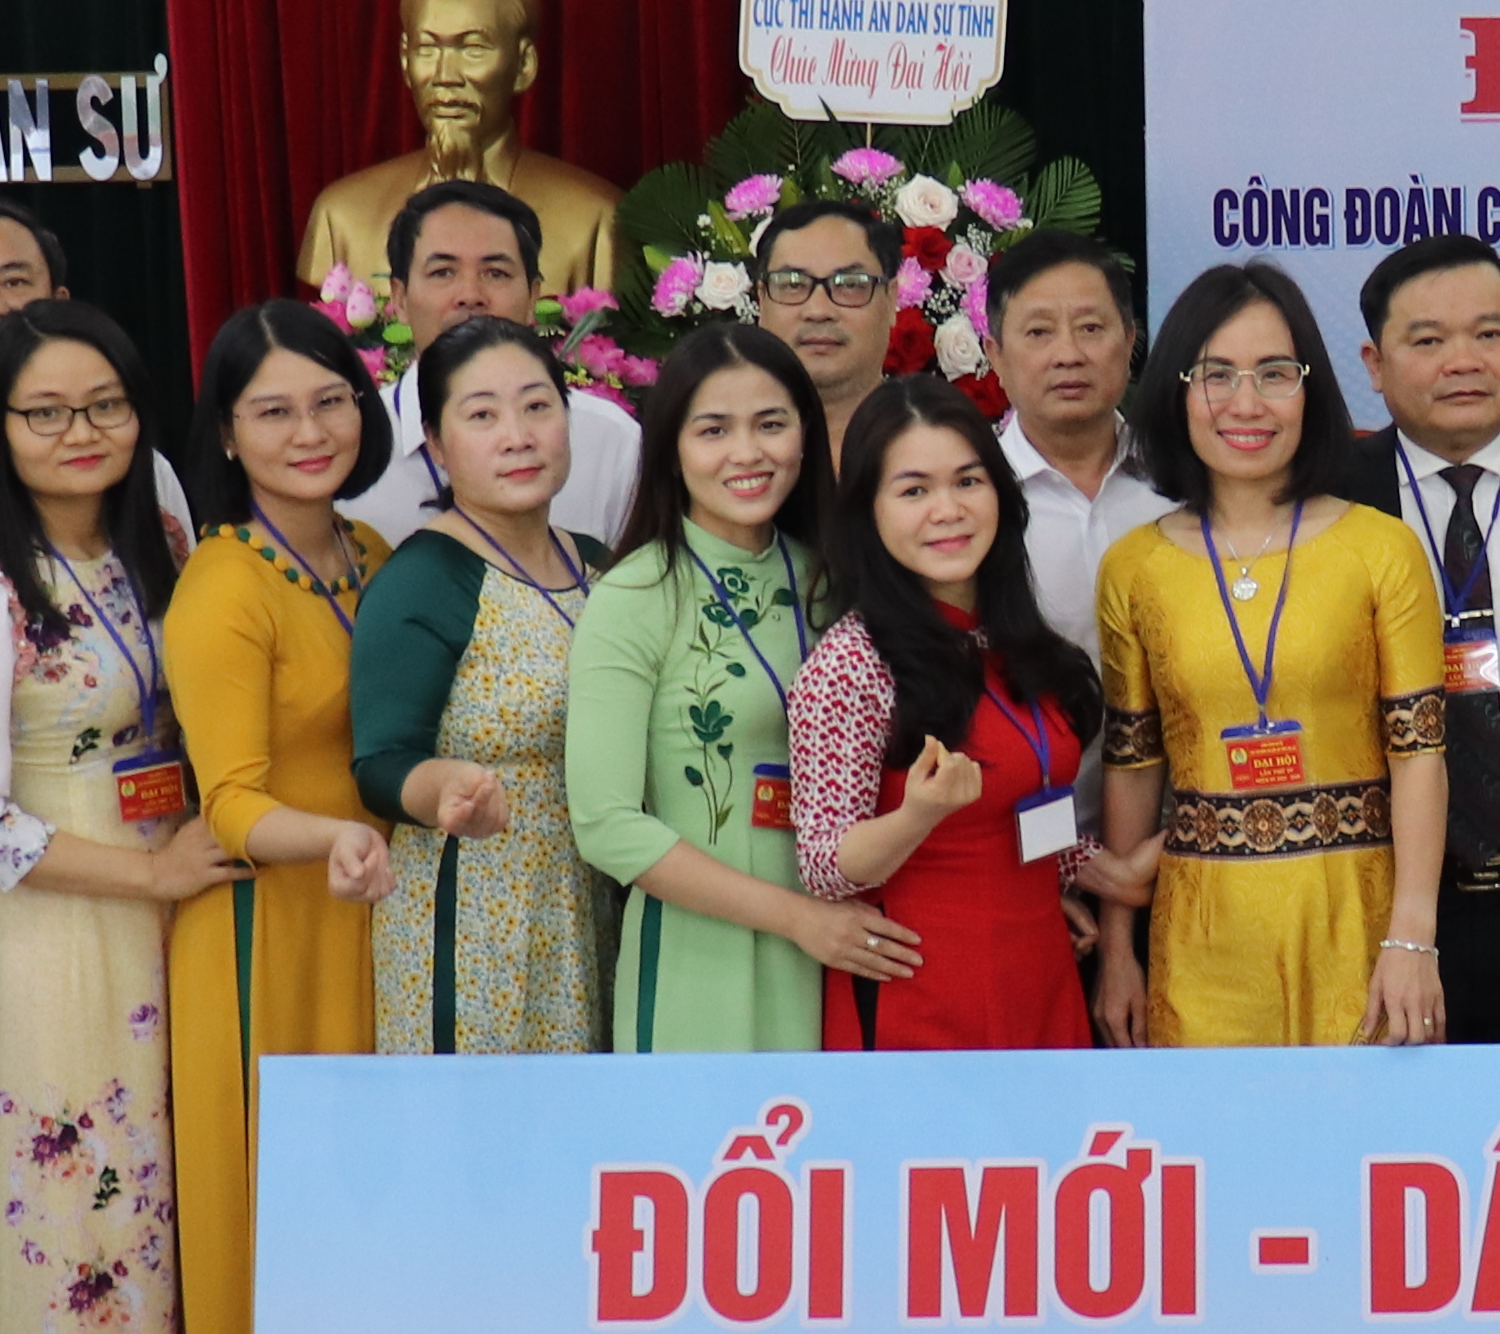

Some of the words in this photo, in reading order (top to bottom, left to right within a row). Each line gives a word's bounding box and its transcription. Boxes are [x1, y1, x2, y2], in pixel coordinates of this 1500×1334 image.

[933, 1, 957, 44] SỰ
[769, 35, 817, 86] Chúc
[820, 37, 880, 99] Mừng
[886, 40, 927, 99] Đại
[932, 42, 974, 102] Hội
[1213, 175, 1329, 247] CÔNG
[1343, 173, 1462, 246] ĐOÀN
[592, 1103, 845, 1322] ĐỔI
[907, 1130, 1197, 1319] MỚI
[1260, 1236, 1309, 1265] -
